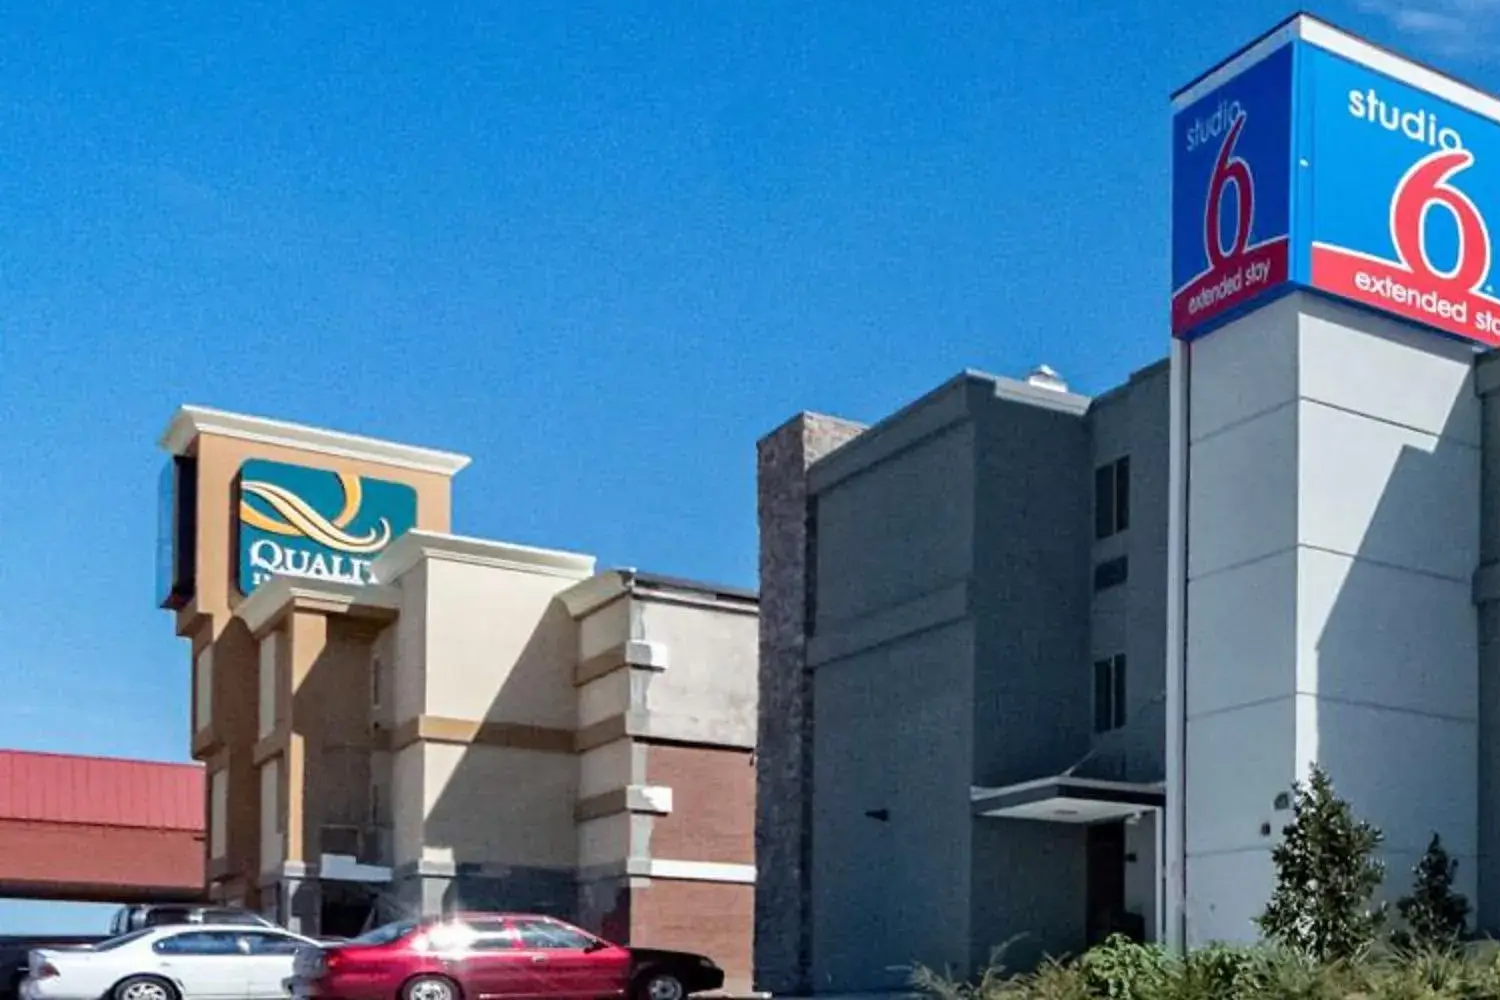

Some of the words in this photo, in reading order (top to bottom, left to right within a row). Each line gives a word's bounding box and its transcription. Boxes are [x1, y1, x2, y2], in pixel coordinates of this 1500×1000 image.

[1186, 100, 1242, 151] studio
[1348, 88, 1463, 152] studio
[1204, 109, 1255, 271] 6
[1390, 147, 1492, 293] 6
[1187, 266, 1243, 315] extended
[1244, 257, 1272, 287] stay
[1354, 269, 1468, 324] extended
[250, 539, 380, 585] QUALIT
